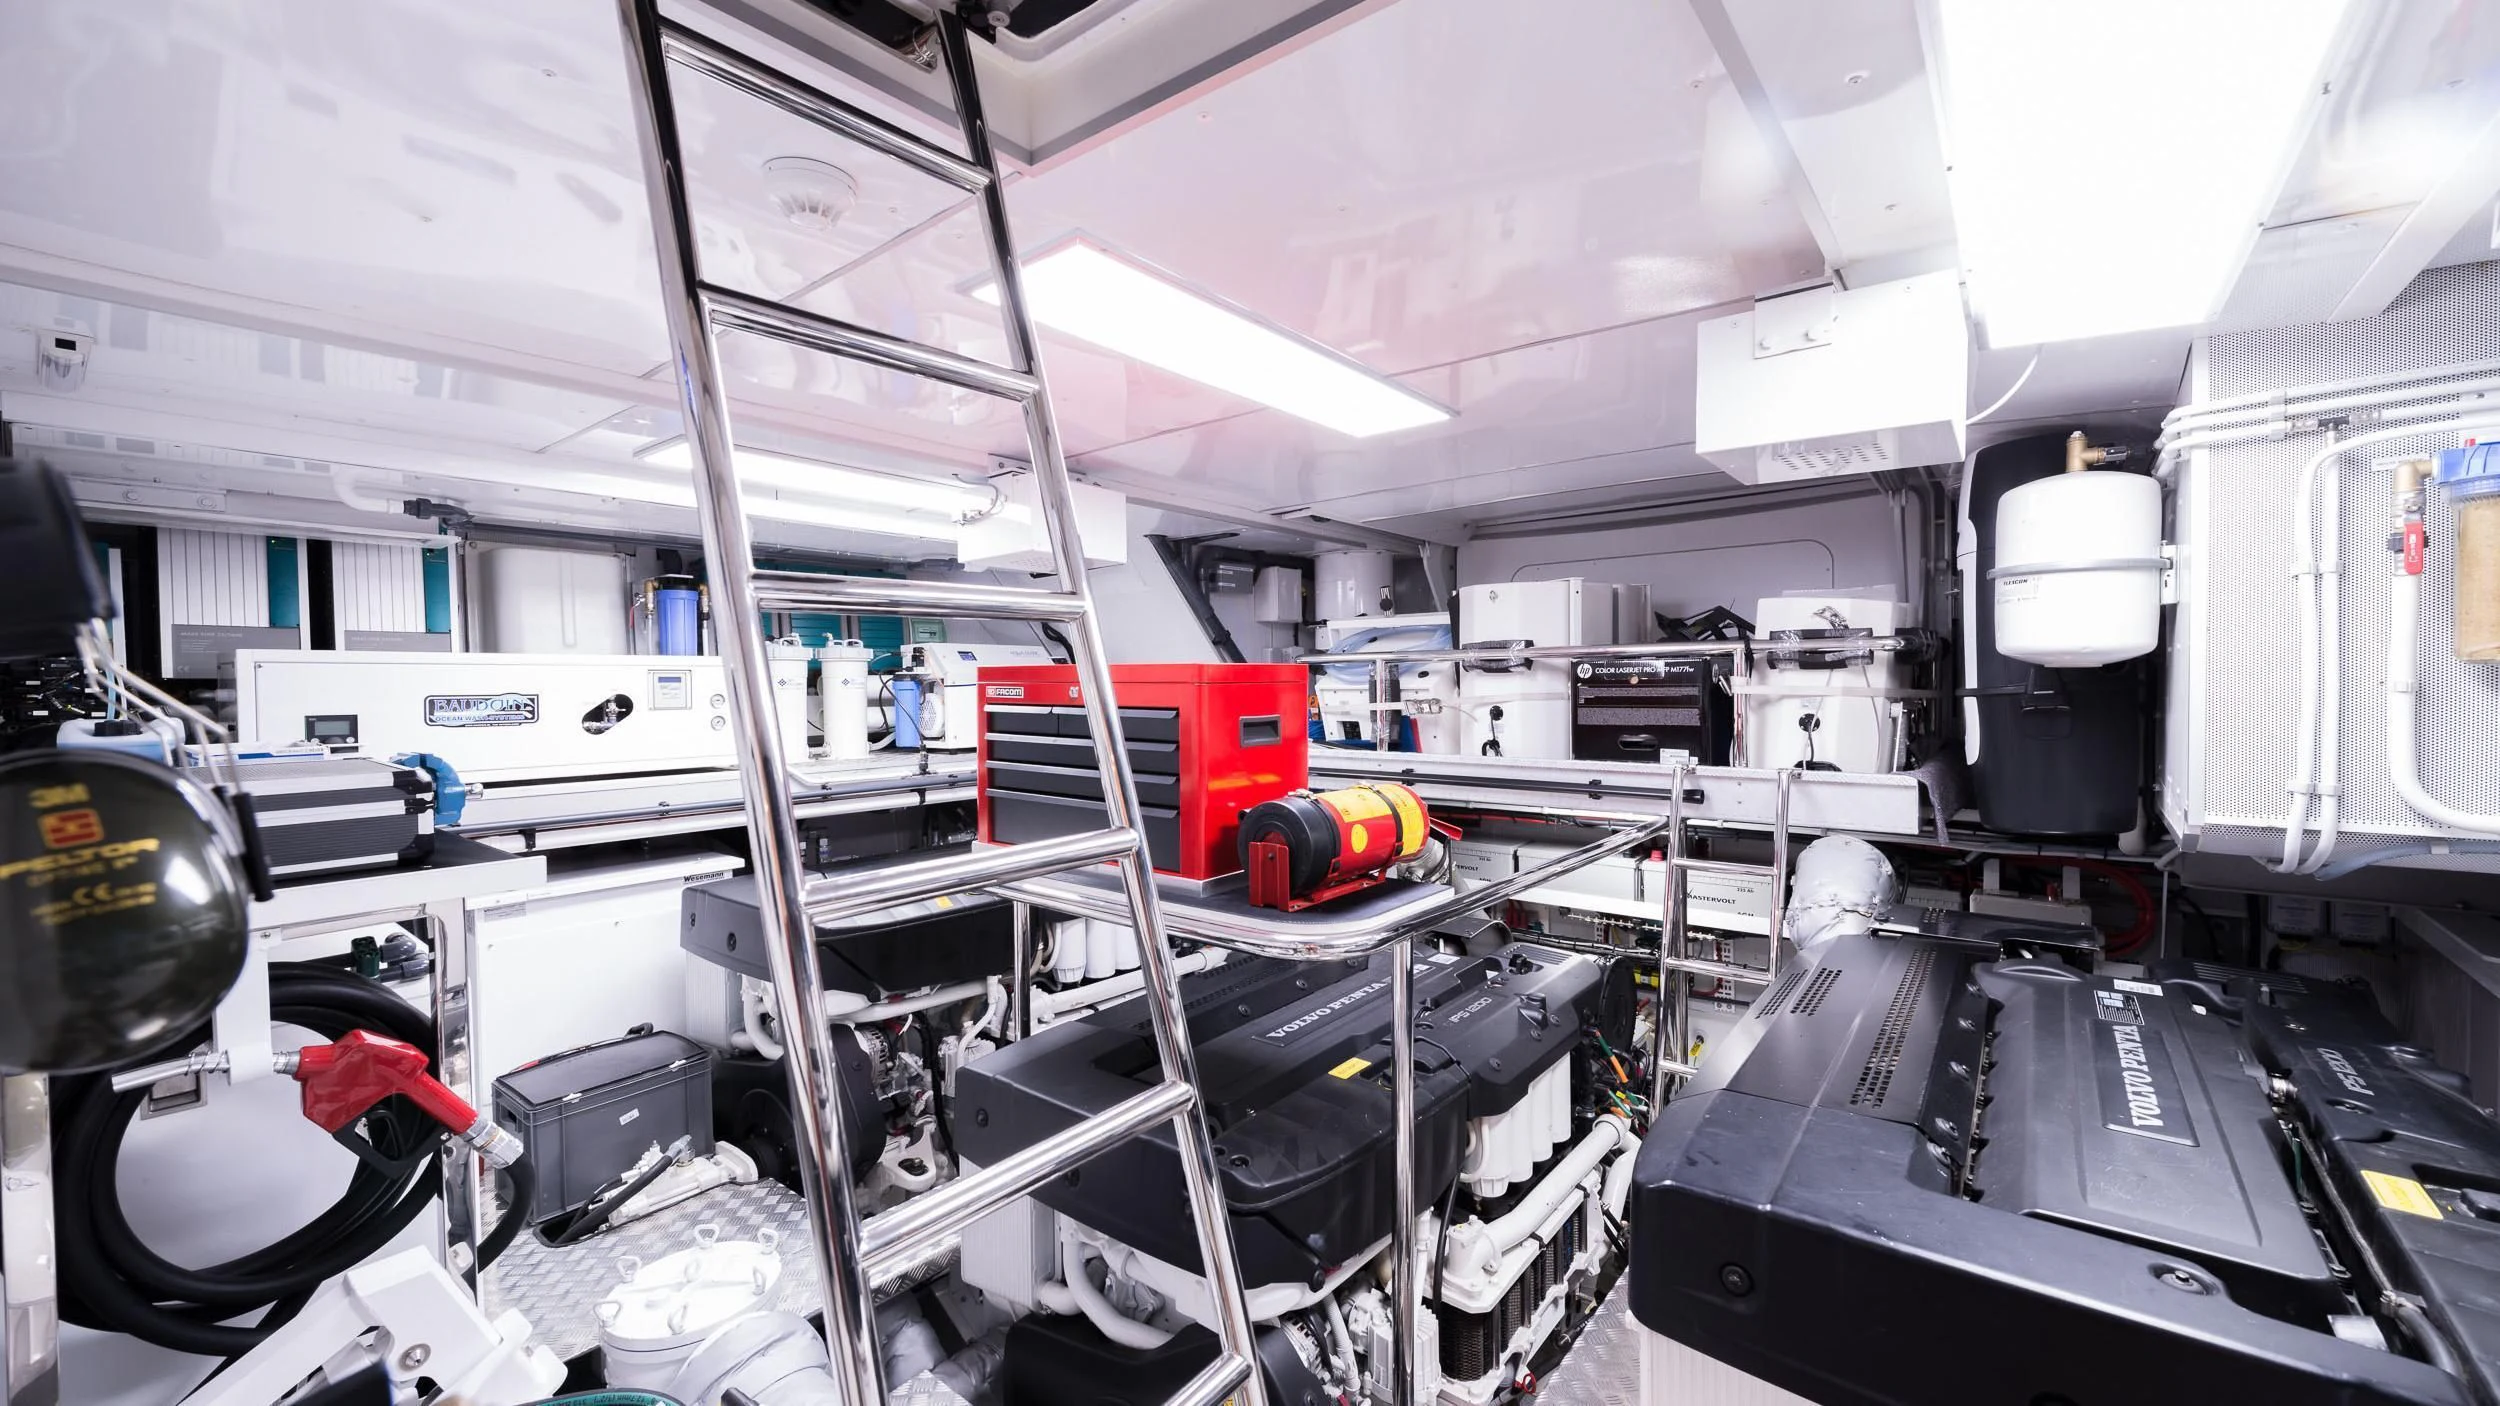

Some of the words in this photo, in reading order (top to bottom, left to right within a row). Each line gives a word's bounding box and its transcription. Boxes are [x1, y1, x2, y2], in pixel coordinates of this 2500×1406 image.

[1616, 666, 1643, 674] LASERJET
[996, 688, 1022, 696] FACOM
[433, 699, 525, 712] BAUDOIN
[683, 872, 724, 882] Wesemann
[1266, 1006, 1332, 1039] VOLVO
[1326, 981, 1387, 1010] PENTA
[1465, 997, 1493, 1013] 1200
[2112, 1025, 2150, 1072] PENTA
[2122, 1070, 2164, 1126] VOLVO
